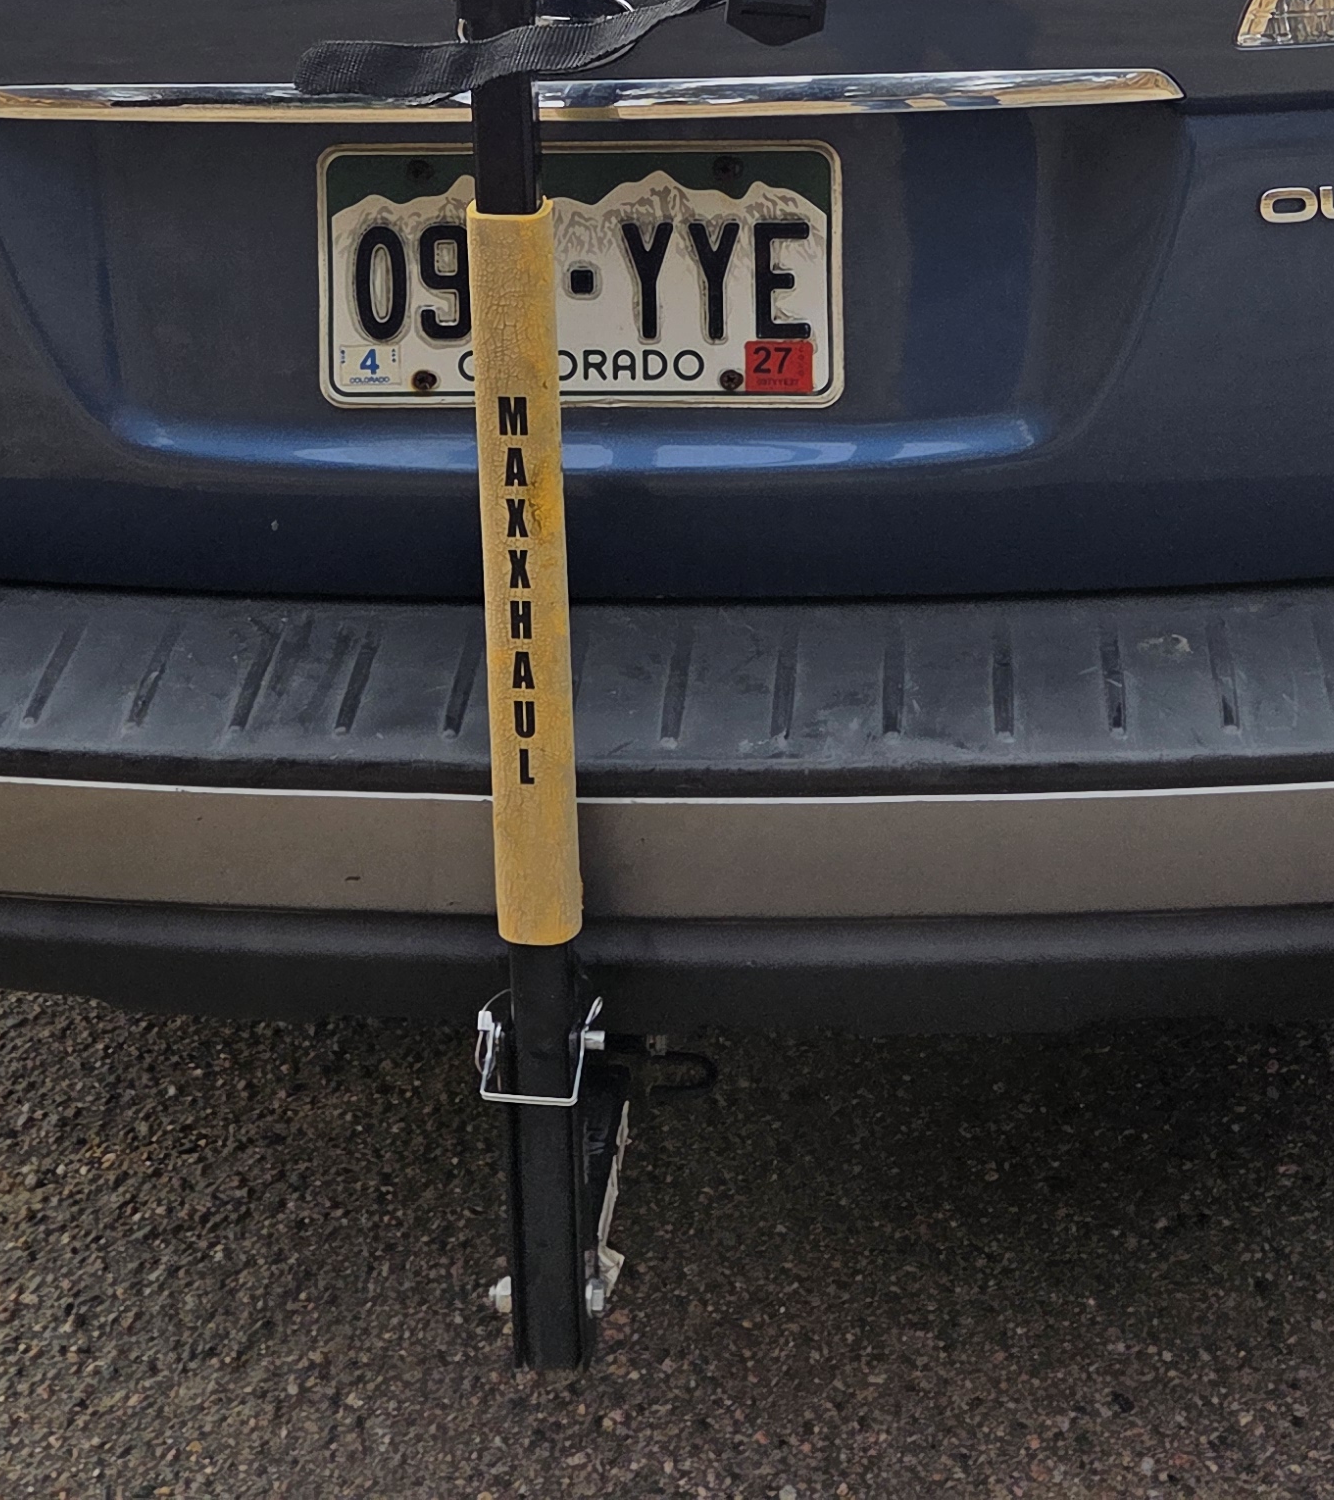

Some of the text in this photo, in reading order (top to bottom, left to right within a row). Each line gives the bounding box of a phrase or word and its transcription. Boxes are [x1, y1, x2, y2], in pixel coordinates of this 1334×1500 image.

[359, 348, 380, 375] 4
[457, 348, 705, 381] CORADO
[753, 345, 793, 375] 27
[497, 396, 535, 786] MAXXHAUL
